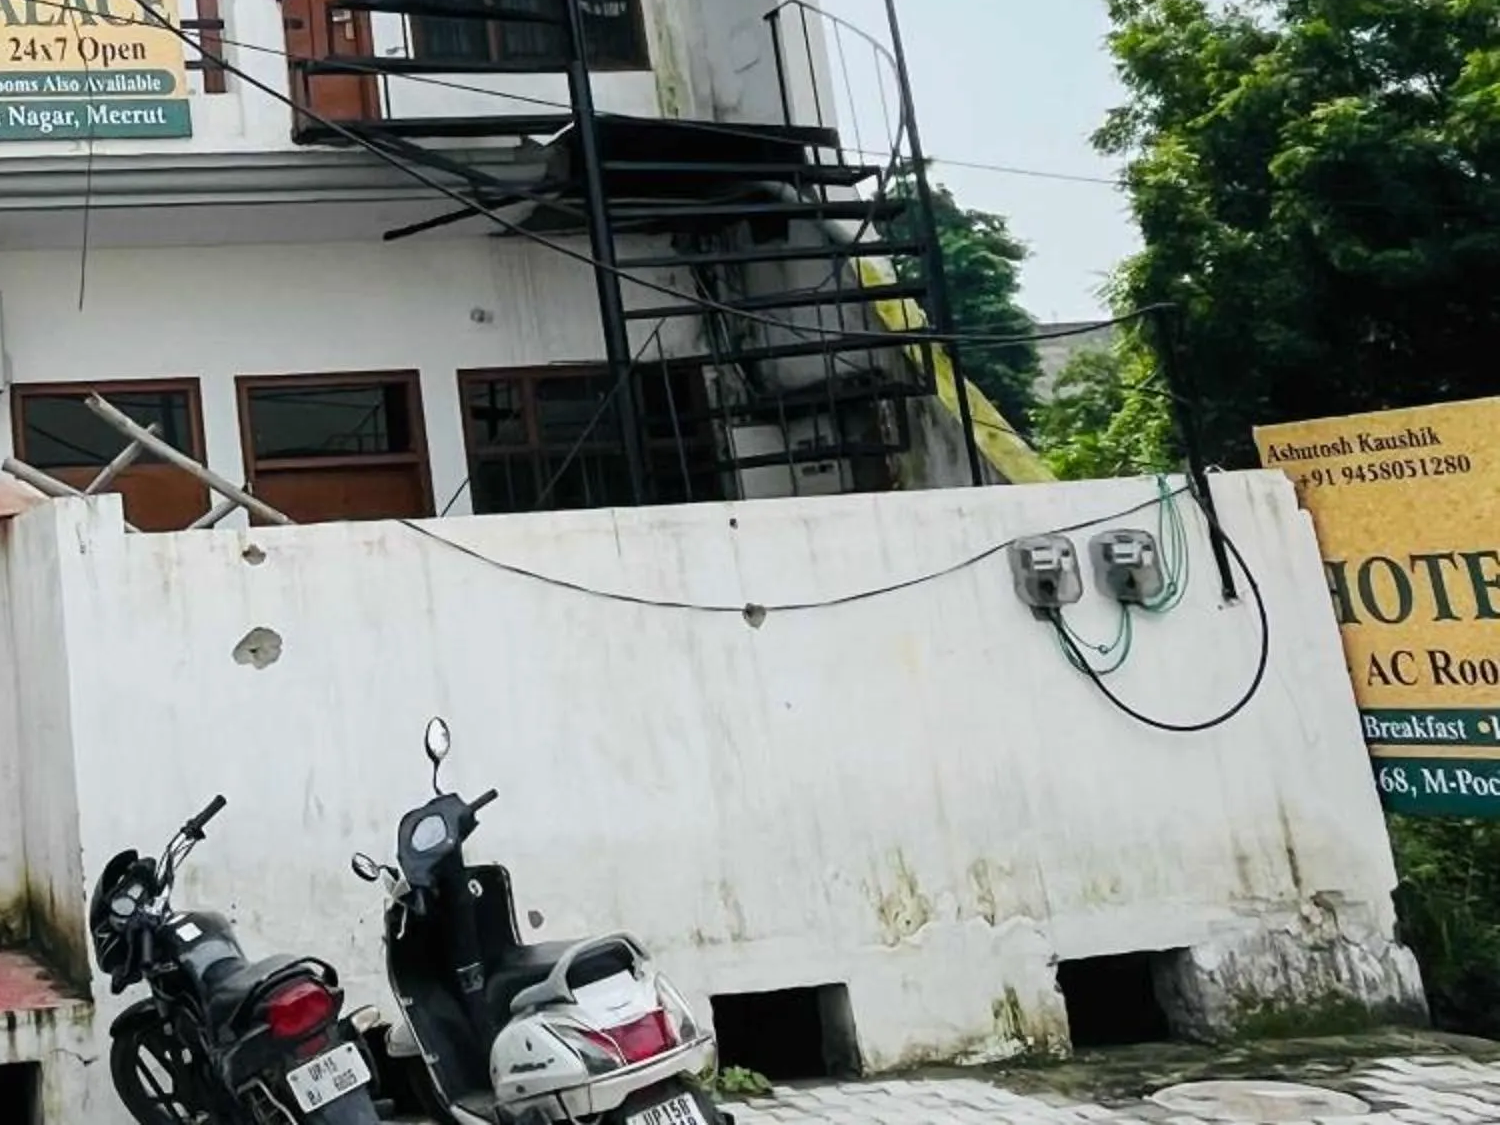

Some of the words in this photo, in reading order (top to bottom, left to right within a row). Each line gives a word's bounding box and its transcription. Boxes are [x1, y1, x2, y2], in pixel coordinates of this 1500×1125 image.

[9, 36, 68, 62] 24x7
[78, 36, 147, 67] Open
[43, 75, 80, 93] Also
[84, 74, 162, 92] Available
[8, 105, 80, 135] Nagar,
[87, 104, 167, 126] Meerut
[1267, 435, 1354, 464] Ashutosh
[1358, 426, 1442, 455] Kaushik
[1299, 468, 1337, 488] +91
[1341, 453, 1472, 486] 9458051280
[1367, 649, 1418, 687] AC
[1425, 649, 1500, 687] Roo
[1363, 715, 1467, 740] Breakfast
[1379, 766, 1418, 799] 68,
[1420, 767, 1500, 797] M-Poc
